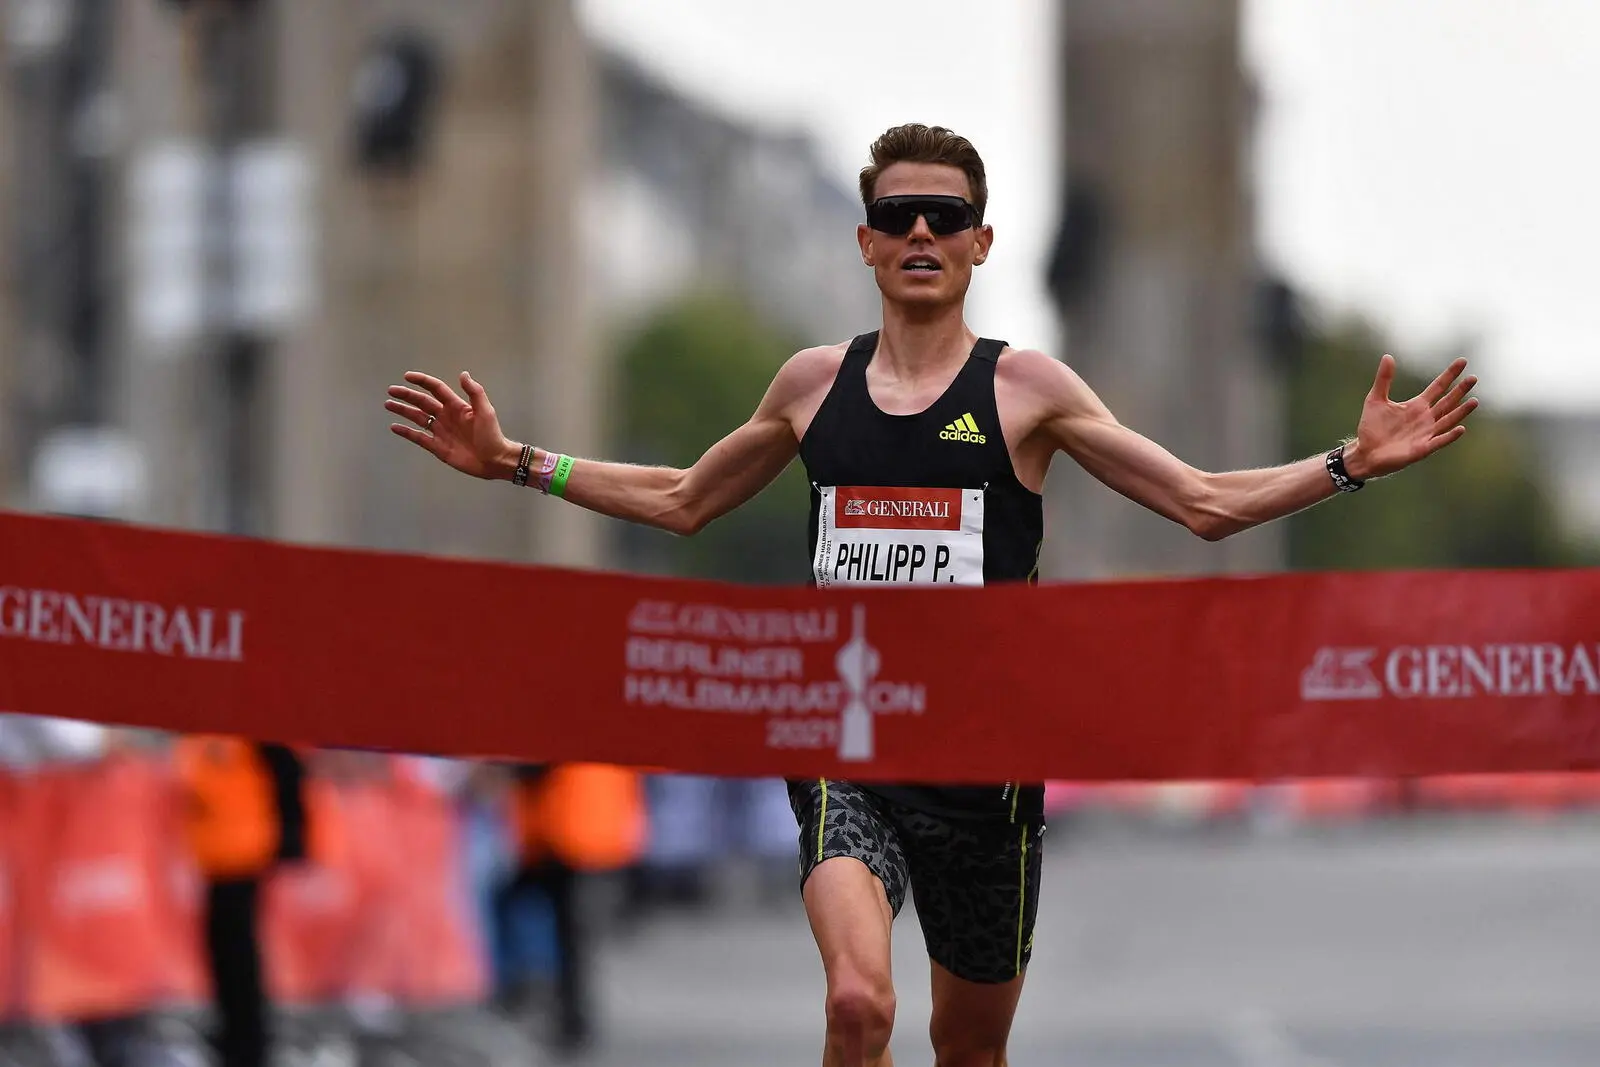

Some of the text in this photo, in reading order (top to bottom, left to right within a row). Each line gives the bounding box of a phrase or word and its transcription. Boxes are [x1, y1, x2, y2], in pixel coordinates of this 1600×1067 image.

[939, 430, 986, 444] adidas
[867, 500, 950, 518] GENERALI
[834, 543, 954, 582] PHILIPP P.
[0, 586, 244, 661] GENERALI
[677, 604, 838, 641] GENERALI
[625, 637, 803, 677] BERLINER
[1385, 642, 1600, 698] GENERA
[766, 719, 840, 748] 2021
